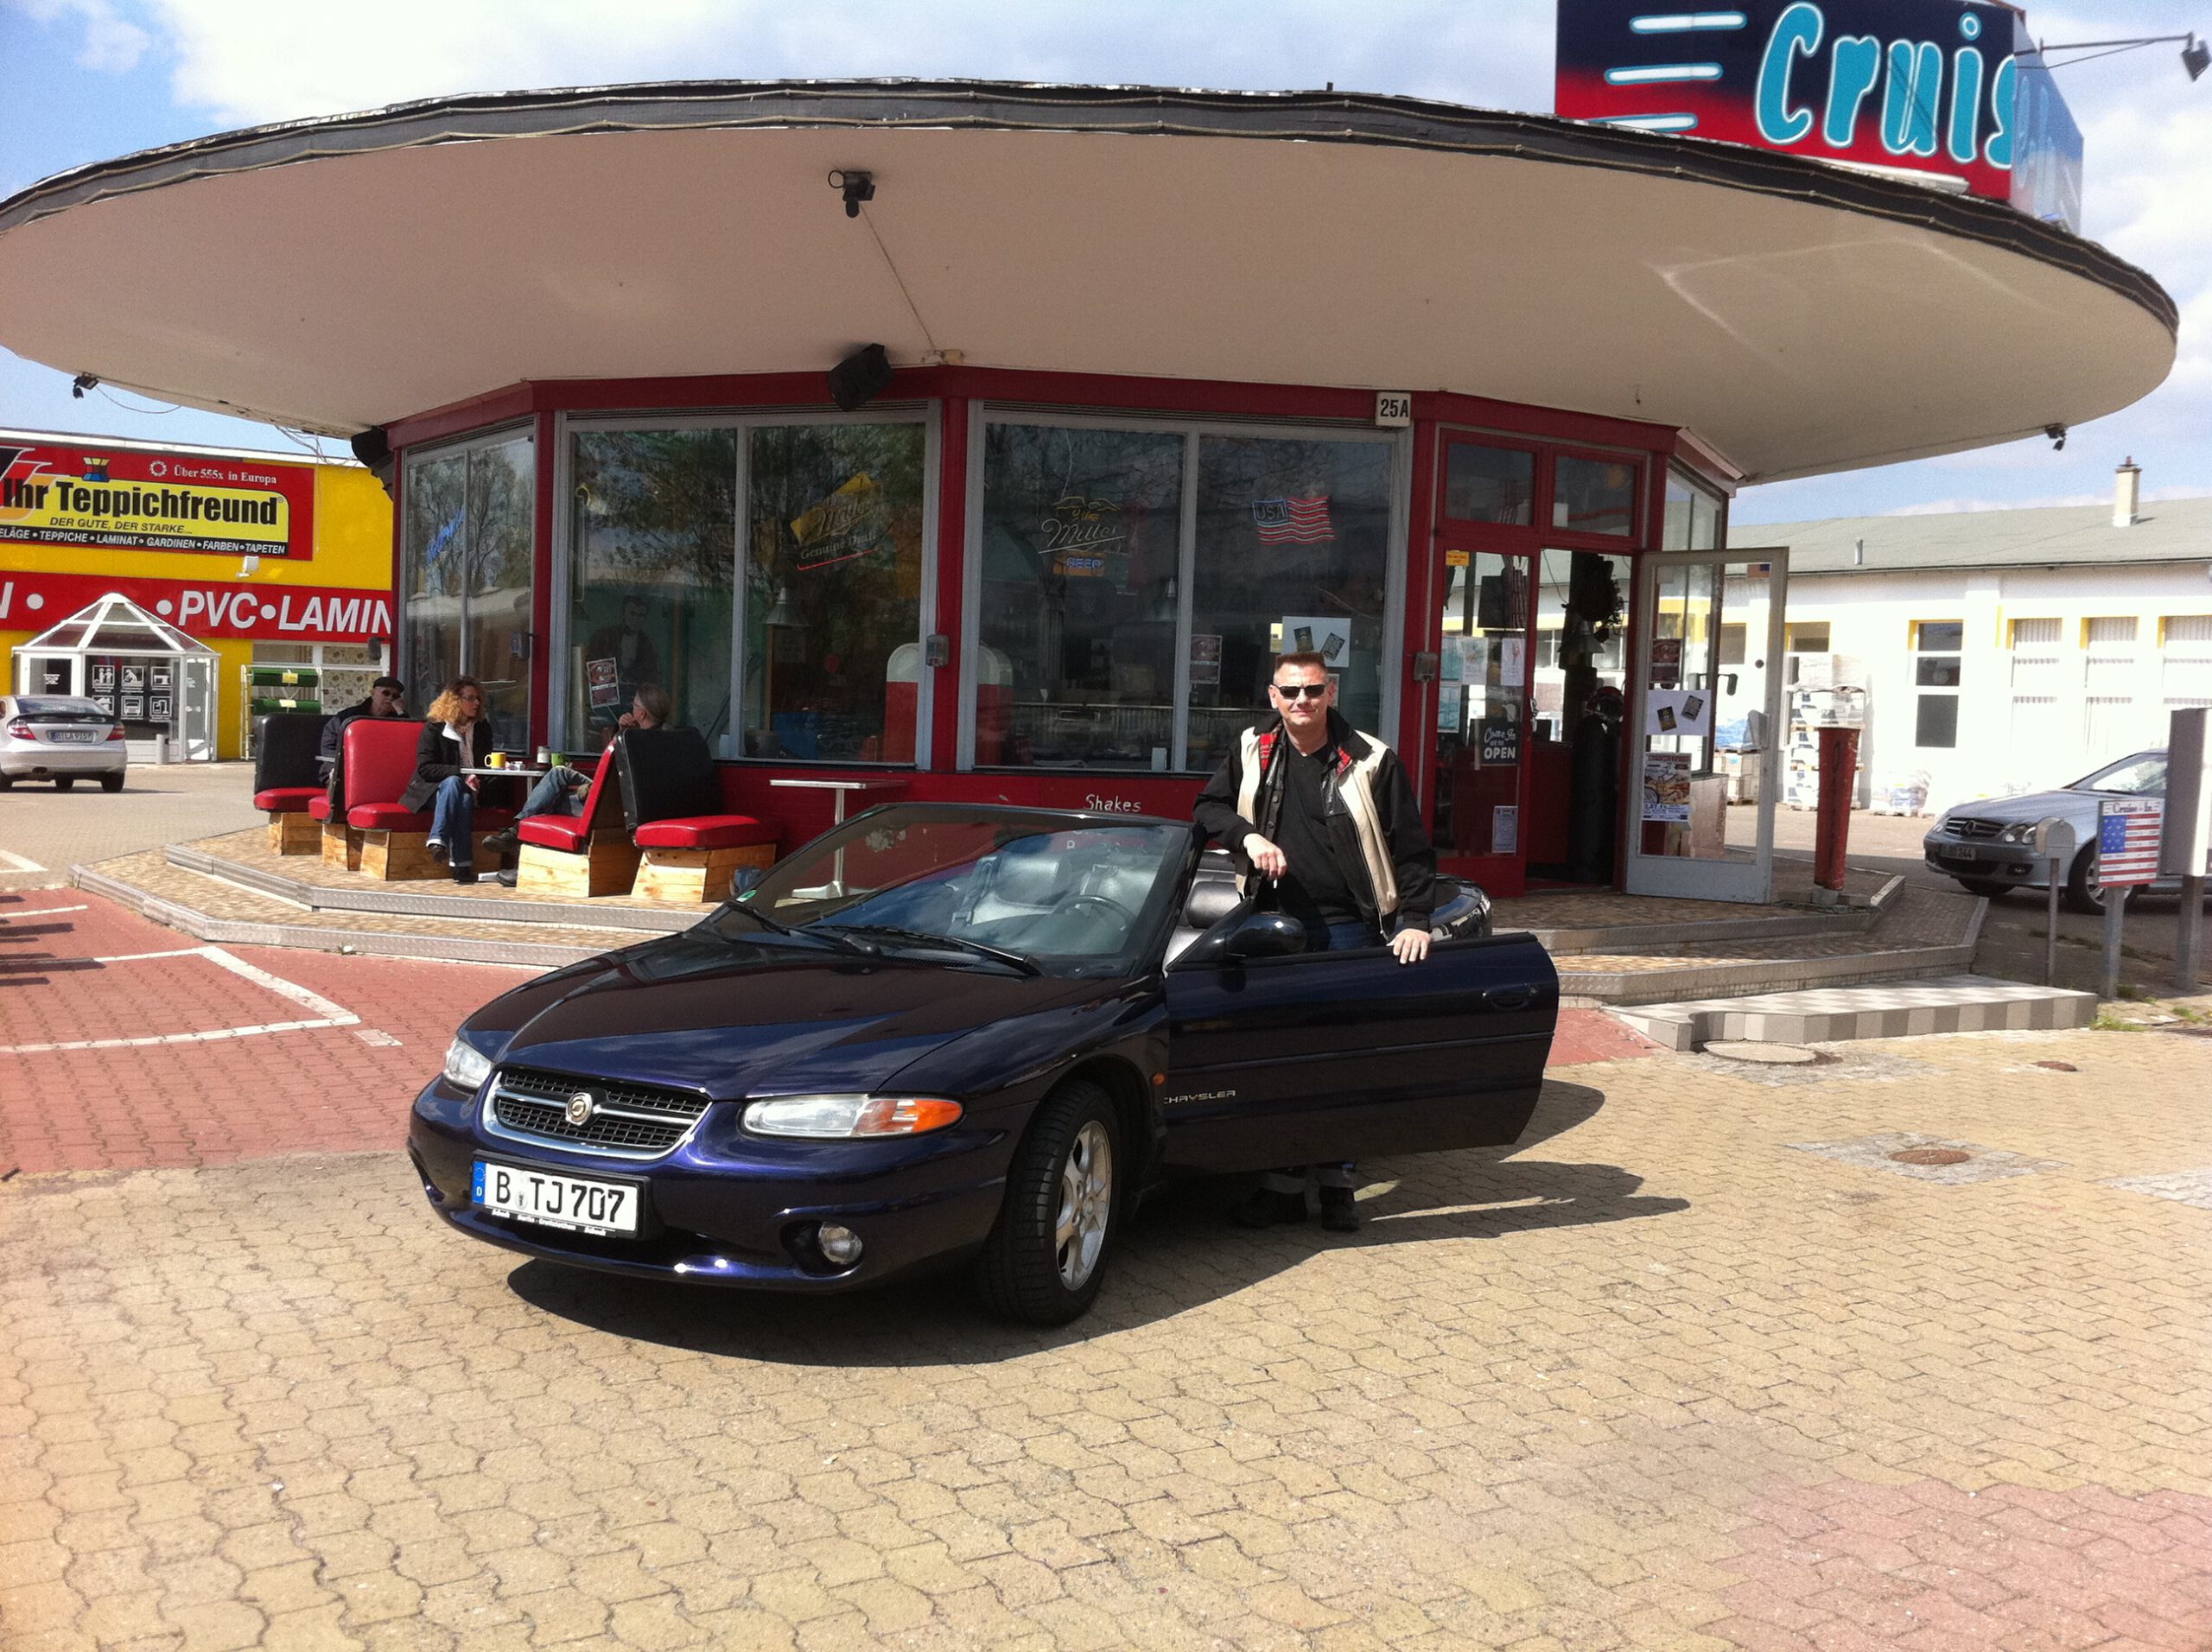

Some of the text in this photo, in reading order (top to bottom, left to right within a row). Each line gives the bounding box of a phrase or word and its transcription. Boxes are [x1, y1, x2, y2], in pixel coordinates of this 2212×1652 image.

[1380, 398, 1408, 418] 25A
[174, 464, 277, 486] Über 555x in Europa
[3, 478, 277, 525] Ihr Teppichfreund
[1256, 504, 1286, 520] USA
[49, 517, 74, 526] DER
[78, 518, 111, 531] GUTE,
[114, 521, 139, 531] DER
[40, 530, 88, 543] TEPPICHE
[96, 534, 138, 546] LAMINAT
[146, 537, 195, 550] GARDINEN
[202, 540, 239, 551] FARBEN
[245, 543, 285, 554] TAPETEN
[178, 590, 258, 630] PVC
[1484, 747, 1516, 759] OPEN
[1085, 794, 1141, 812] Shakes
[1163, 1090, 1236, 1104] CHRYSLER
[496, 1171, 512, 1204] B
[530, 1177, 563, 1214] TJ
[571, 1184, 626, 1223] 707
